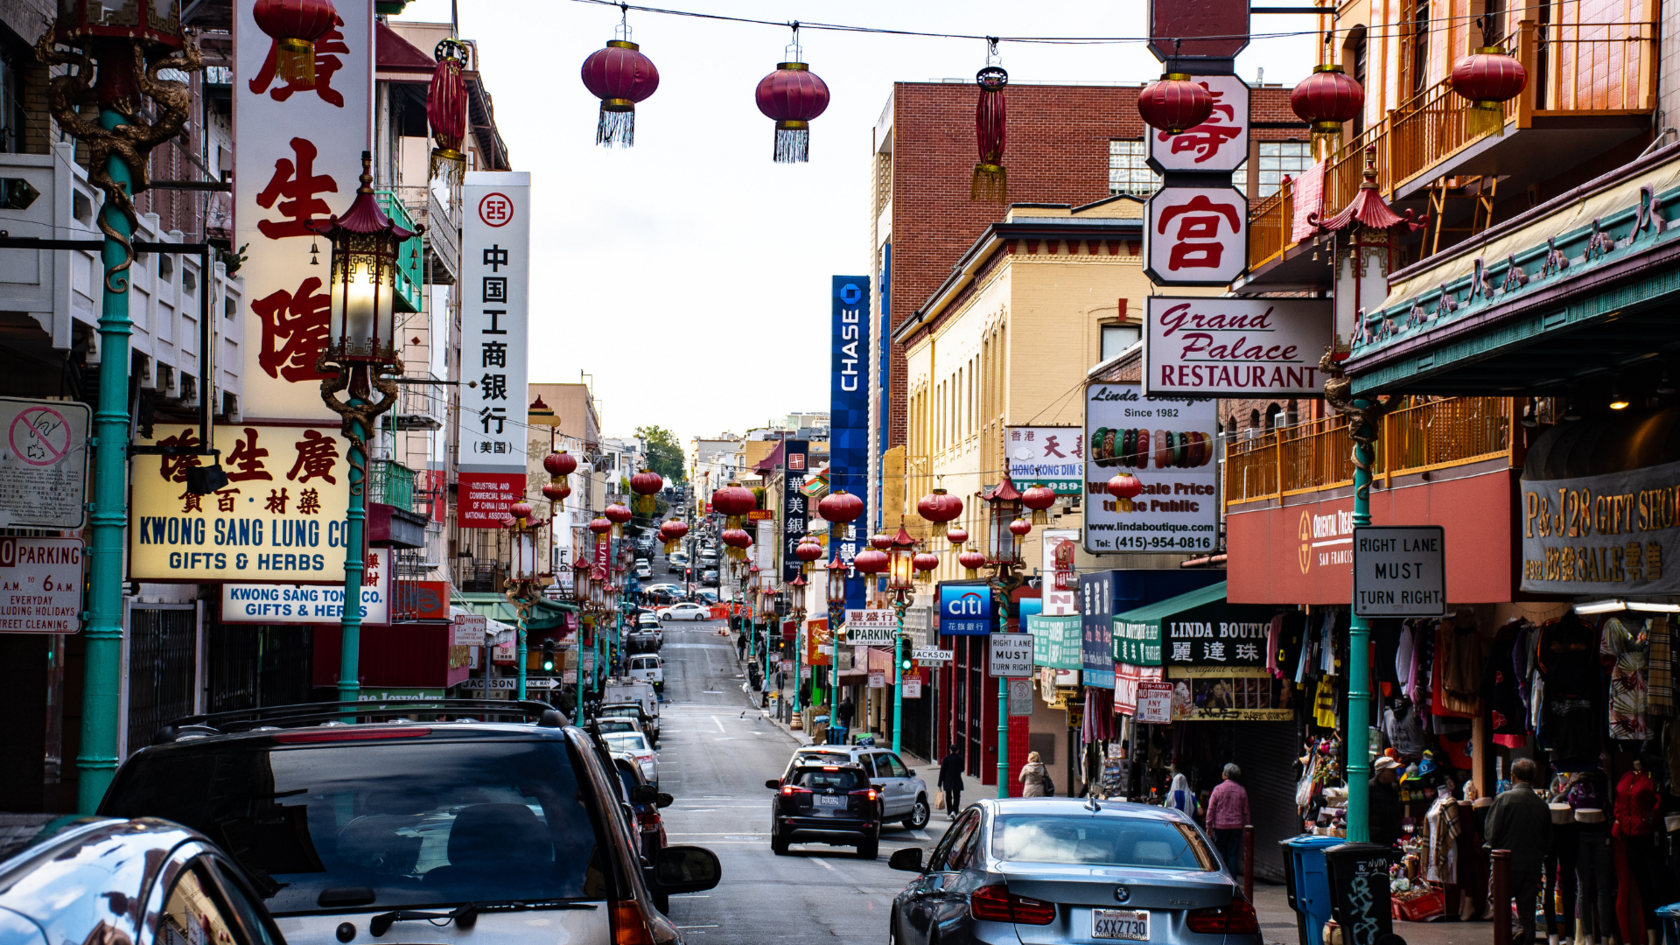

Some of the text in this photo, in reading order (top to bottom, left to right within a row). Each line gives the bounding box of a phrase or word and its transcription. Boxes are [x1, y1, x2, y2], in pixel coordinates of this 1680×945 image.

[1160, 303, 1274, 336] Grand
[480, 244, 508, 434] 中国工商银行
[1180, 333, 1298, 360] Palace
[842, 308, 859, 392] CHASE
[1161, 365, 1318, 388] RESTAURANT
[1091, 387, 1140, 402] Linda
[1124, 408, 1179, 418] Since 1982
[1011, 430, 1034, 442] 香港
[1012, 464, 1034, 476] HONG
[1037, 464, 1060, 476] KONG
[1062, 464, 1076, 476] DIM
[1088, 482, 1214, 496] Wsale Price
[481, 502, 495, 510] CHINA
[1151, 500, 1200, 512] Public
[1594, 493, 1634, 535] GIFT
[140, 516, 206, 546] KWONG
[214, 518, 264, 546] SANG
[272, 519, 320, 548] LUNG
[1089, 522, 1214, 532] www.lindaboutique.com
[1116, 536, 1210, 550] (415)-954-0816
[1360, 538, 1438, 552] RIGHT LANE
[0, 540, 79, 564] O PARKING
[1319, 550, 1352, 566] SAN FRANCIS
[170, 552, 324, 571] GIFTS & HERBS
[1577, 546, 1624, 582] SALE
[1375, 562, 1422, 580] MUST
[3, 582, 22, 591] A.M.
[43, 574, 54, 592] 6
[56, 582, 76, 592] A.M.
[10, 596, 53, 605] EVERYDAY
[230, 588, 382, 604] KWONG SANG TON CO.
[1360, 590, 1440, 604] TURN RIGHT
[0, 606, 75, 616] LUDING HOLIDAYS
[246, 603, 368, 618] GIFTS & HERS
[948, 597, 982, 615] citi
[0, 619, 68, 629] TREET CLEANING
[1170, 622, 1214, 638] LINDA
[1219, 622, 1271, 638] BOUTIQ
[855, 629, 896, 640] PARKING
[996, 651, 1028, 660] MUST
[1096, 919, 1146, 935] 6XXZ730
